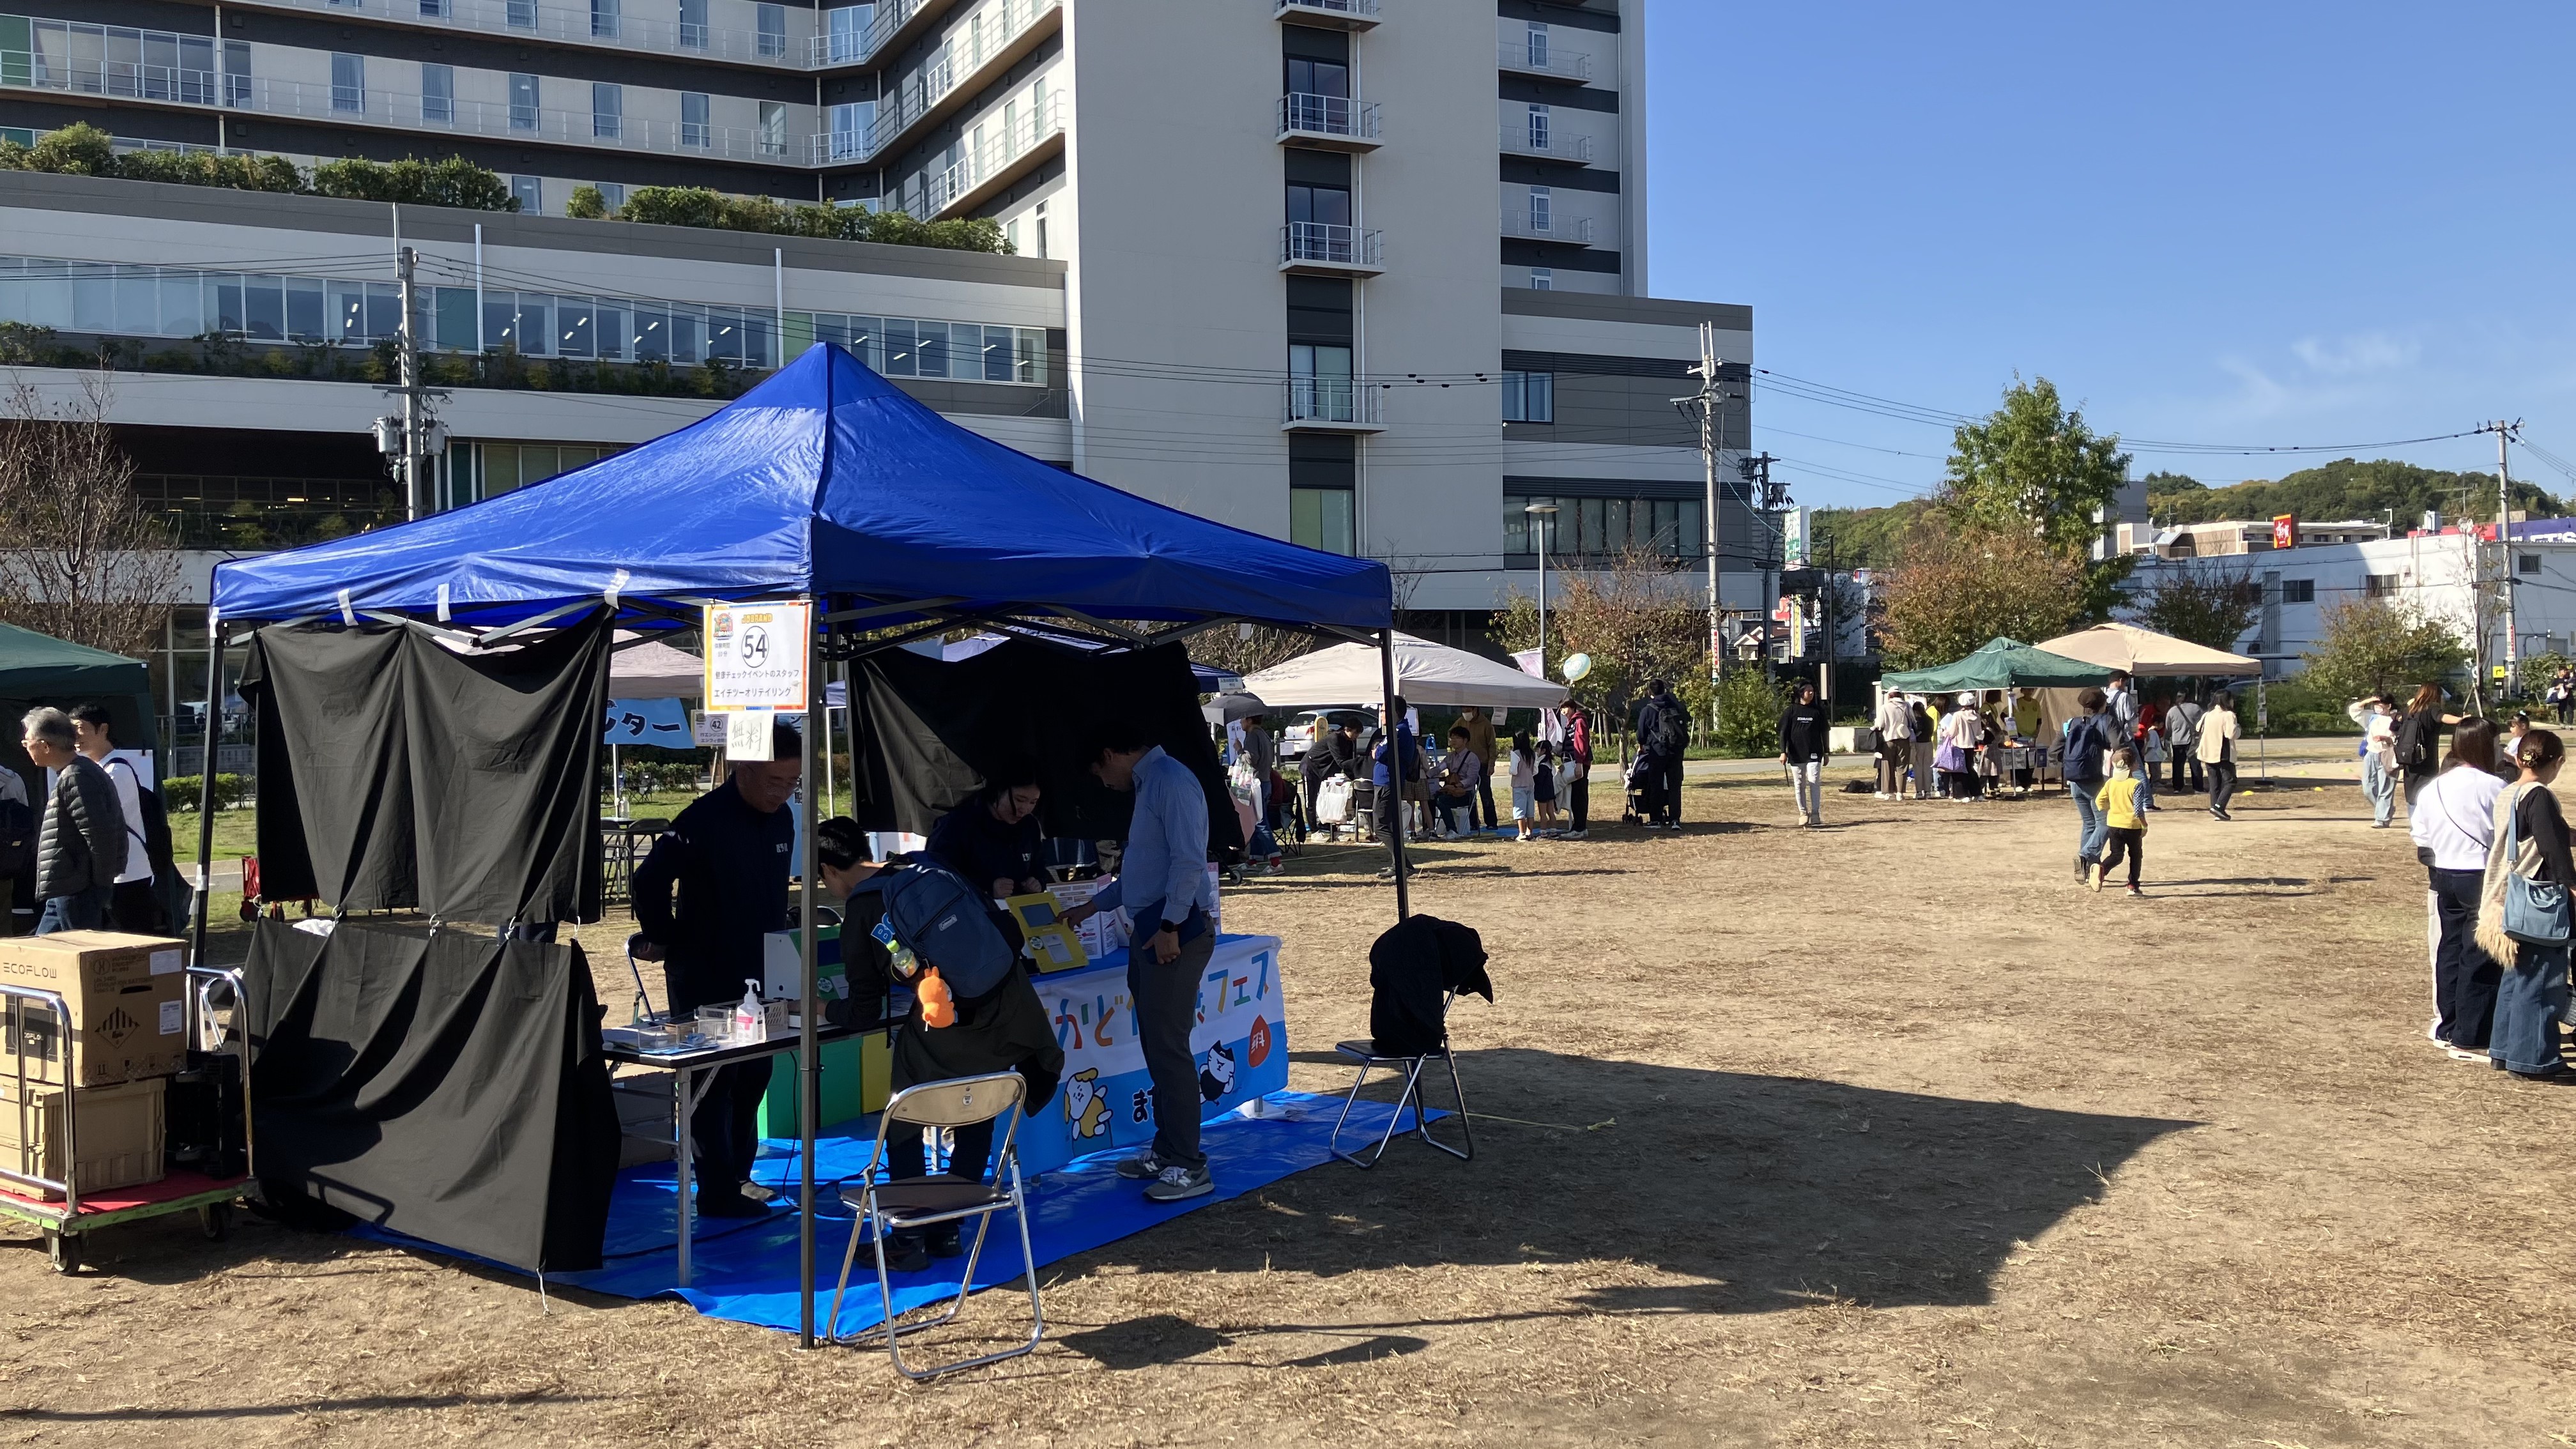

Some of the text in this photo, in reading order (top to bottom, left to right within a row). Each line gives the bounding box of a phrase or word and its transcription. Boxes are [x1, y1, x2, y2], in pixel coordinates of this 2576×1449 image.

[743, 634, 768, 659] 54
[716, 669, 799, 680] 健康チェックイベントのスタッフ
[714, 687, 792, 698] エイチツーオリテイリング
[712, 721, 721, 729] 42
[732, 720, 763, 752] 無料
[3, 962, 57, 979] ECOFLOW
